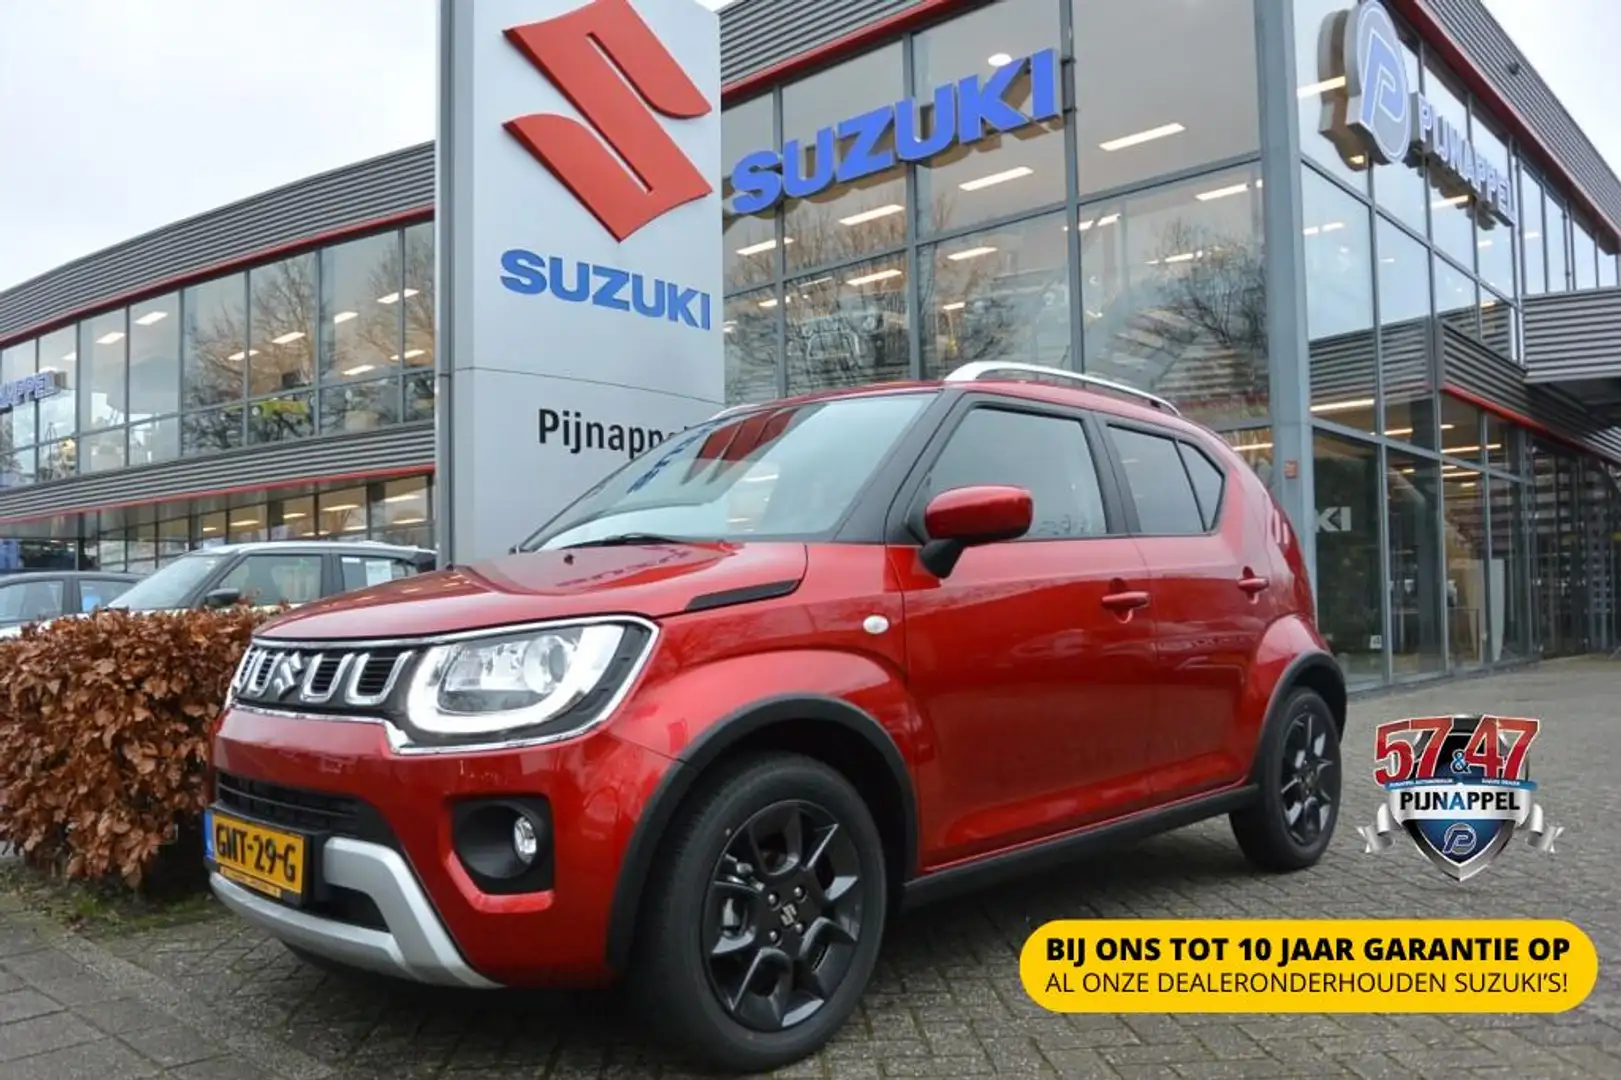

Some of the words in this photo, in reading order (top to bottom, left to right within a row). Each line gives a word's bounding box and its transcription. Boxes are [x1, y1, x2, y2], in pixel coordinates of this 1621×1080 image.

[730, 48, 1059, 216] SUZUKI
[1419, 93, 1515, 225] PIJNAPPEL
[500, 248, 711, 331] SUZUKI
